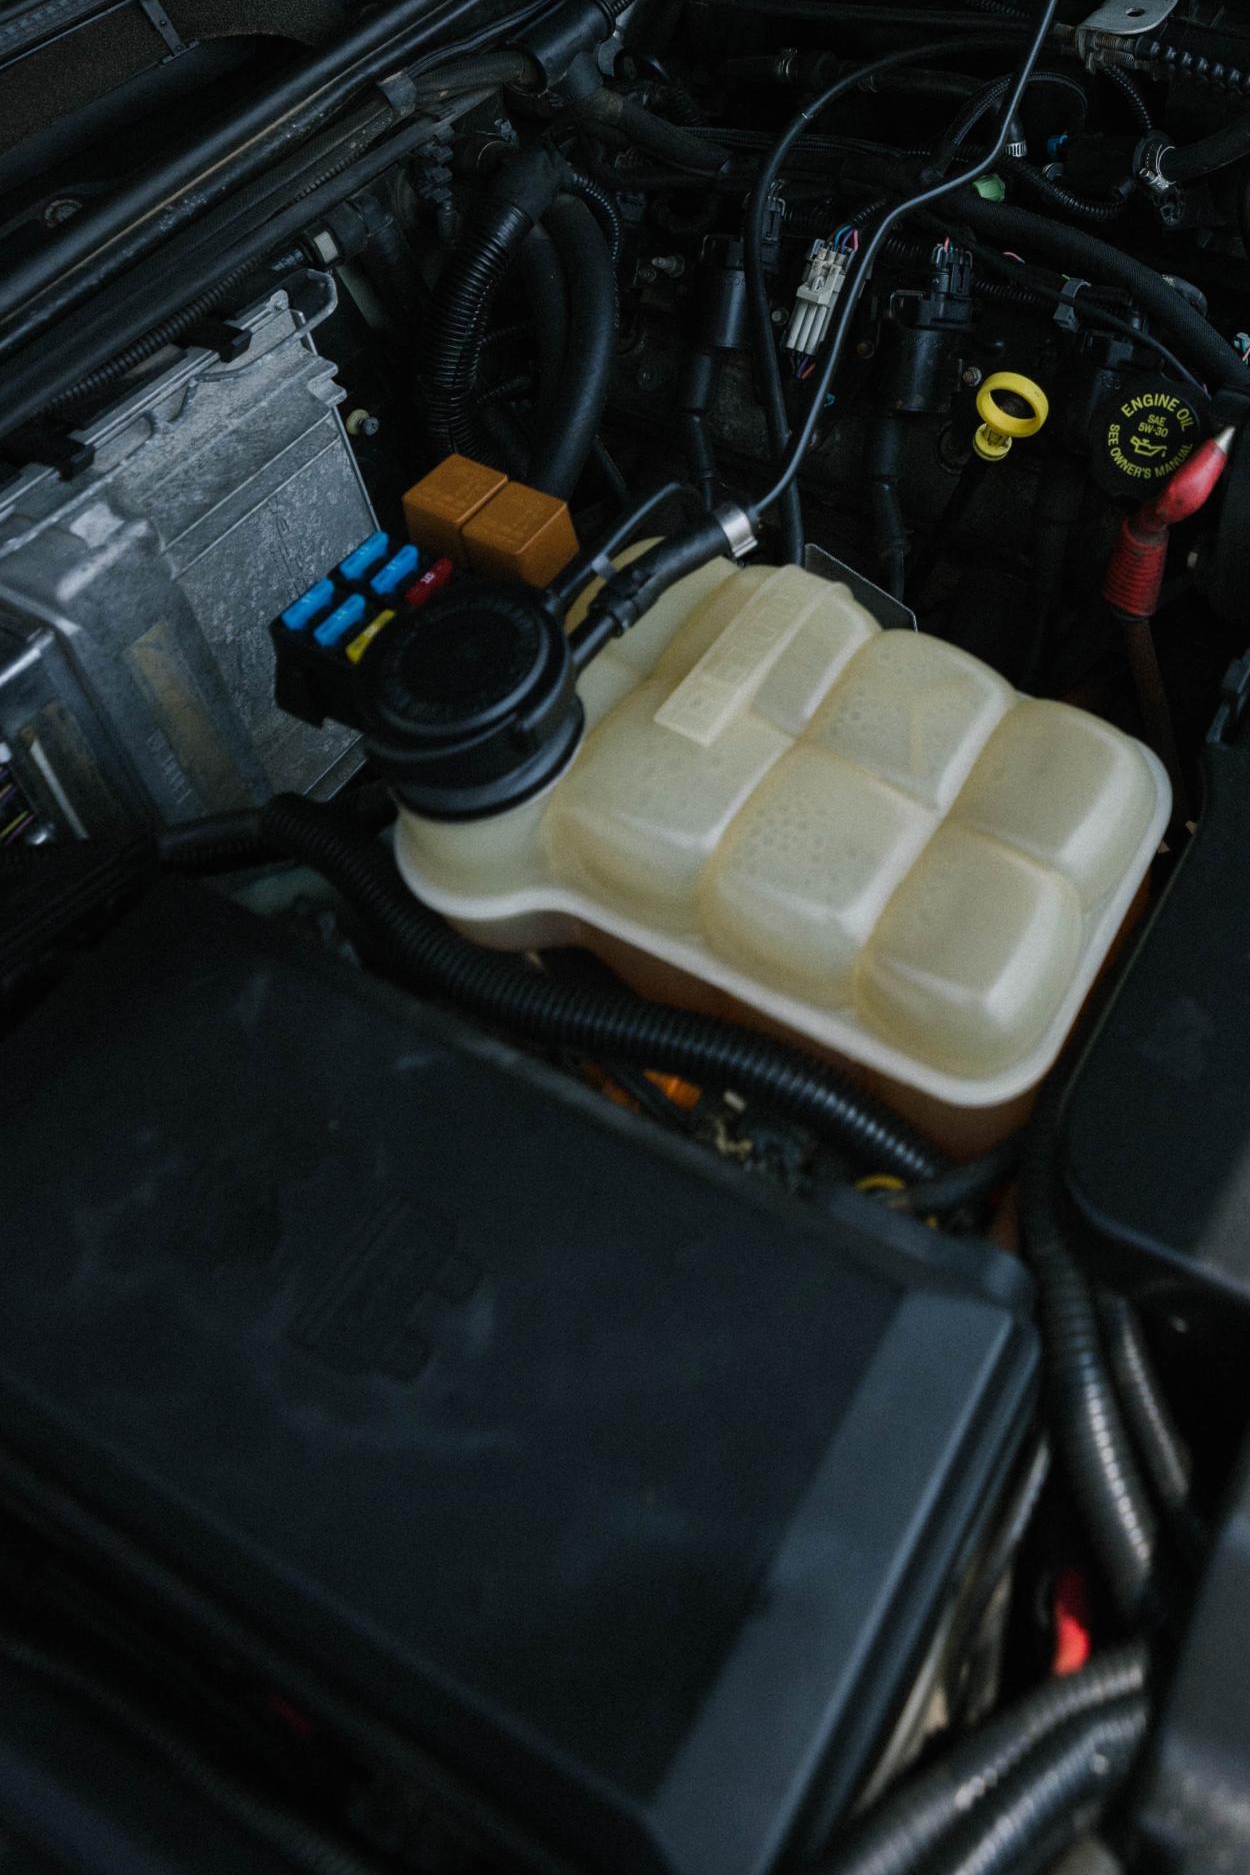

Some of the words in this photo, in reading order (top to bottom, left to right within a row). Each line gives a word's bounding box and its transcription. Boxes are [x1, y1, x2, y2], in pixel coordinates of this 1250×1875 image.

[1121, 393, 1180, 418] ENGINE
[1176, 408, 1195, 432] OIL
[1147, 414, 1167, 427] SAE
[1108, 423, 1121, 446] SEE
[1138, 422, 1169, 438] 5W-30
[1110, 447, 1152, 479] OWNER'S
[1154, 443, 1193, 478] MANUAL
